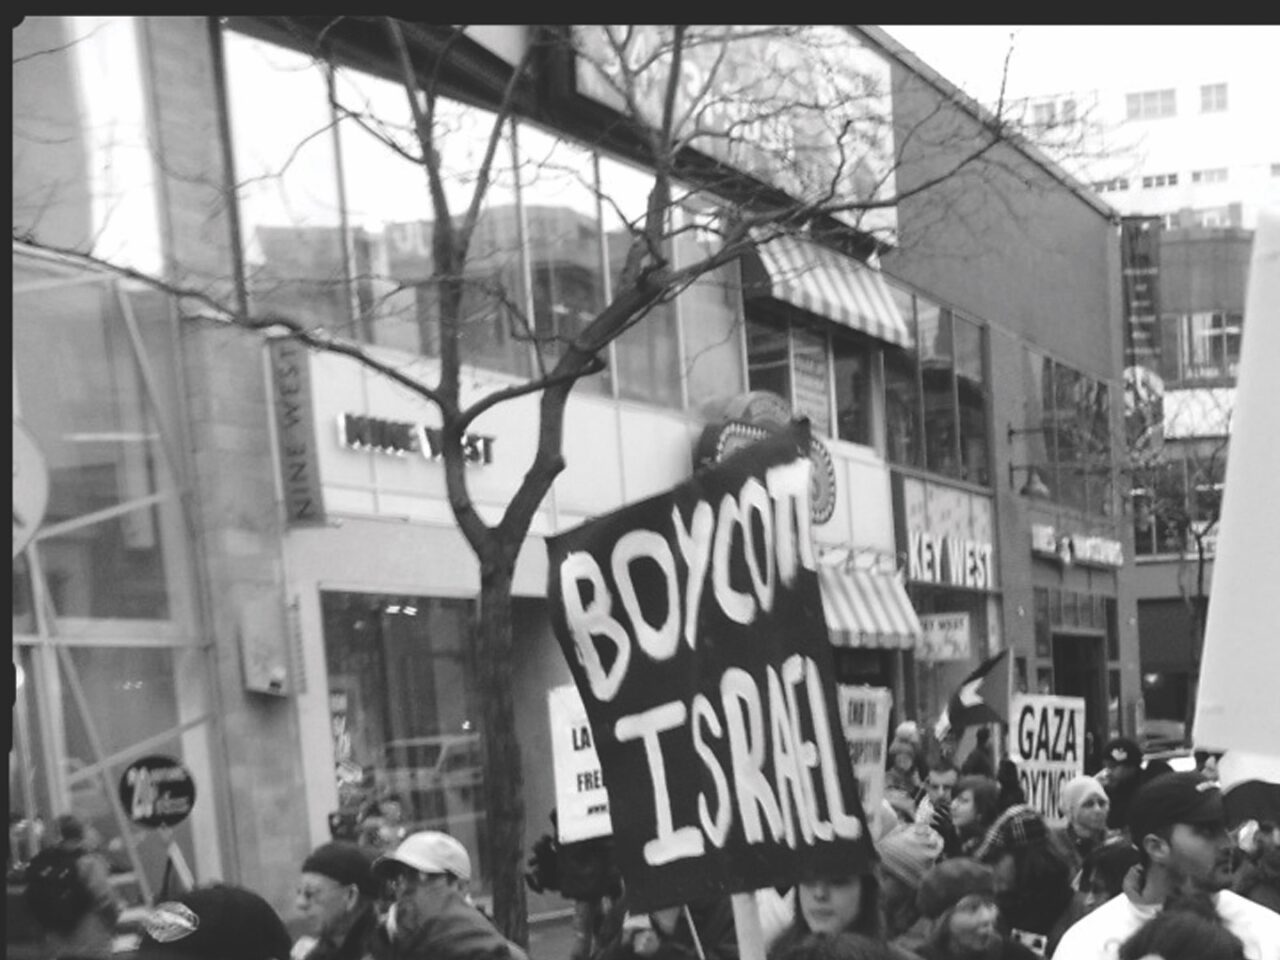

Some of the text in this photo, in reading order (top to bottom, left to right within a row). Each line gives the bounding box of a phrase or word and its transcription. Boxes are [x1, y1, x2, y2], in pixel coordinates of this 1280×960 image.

[908, 530, 943, 584] KEY
[948, 536, 993, 591] WEST
[614, 654, 862, 866] ISRAEL
[1018, 705, 1077, 762] GAZA
